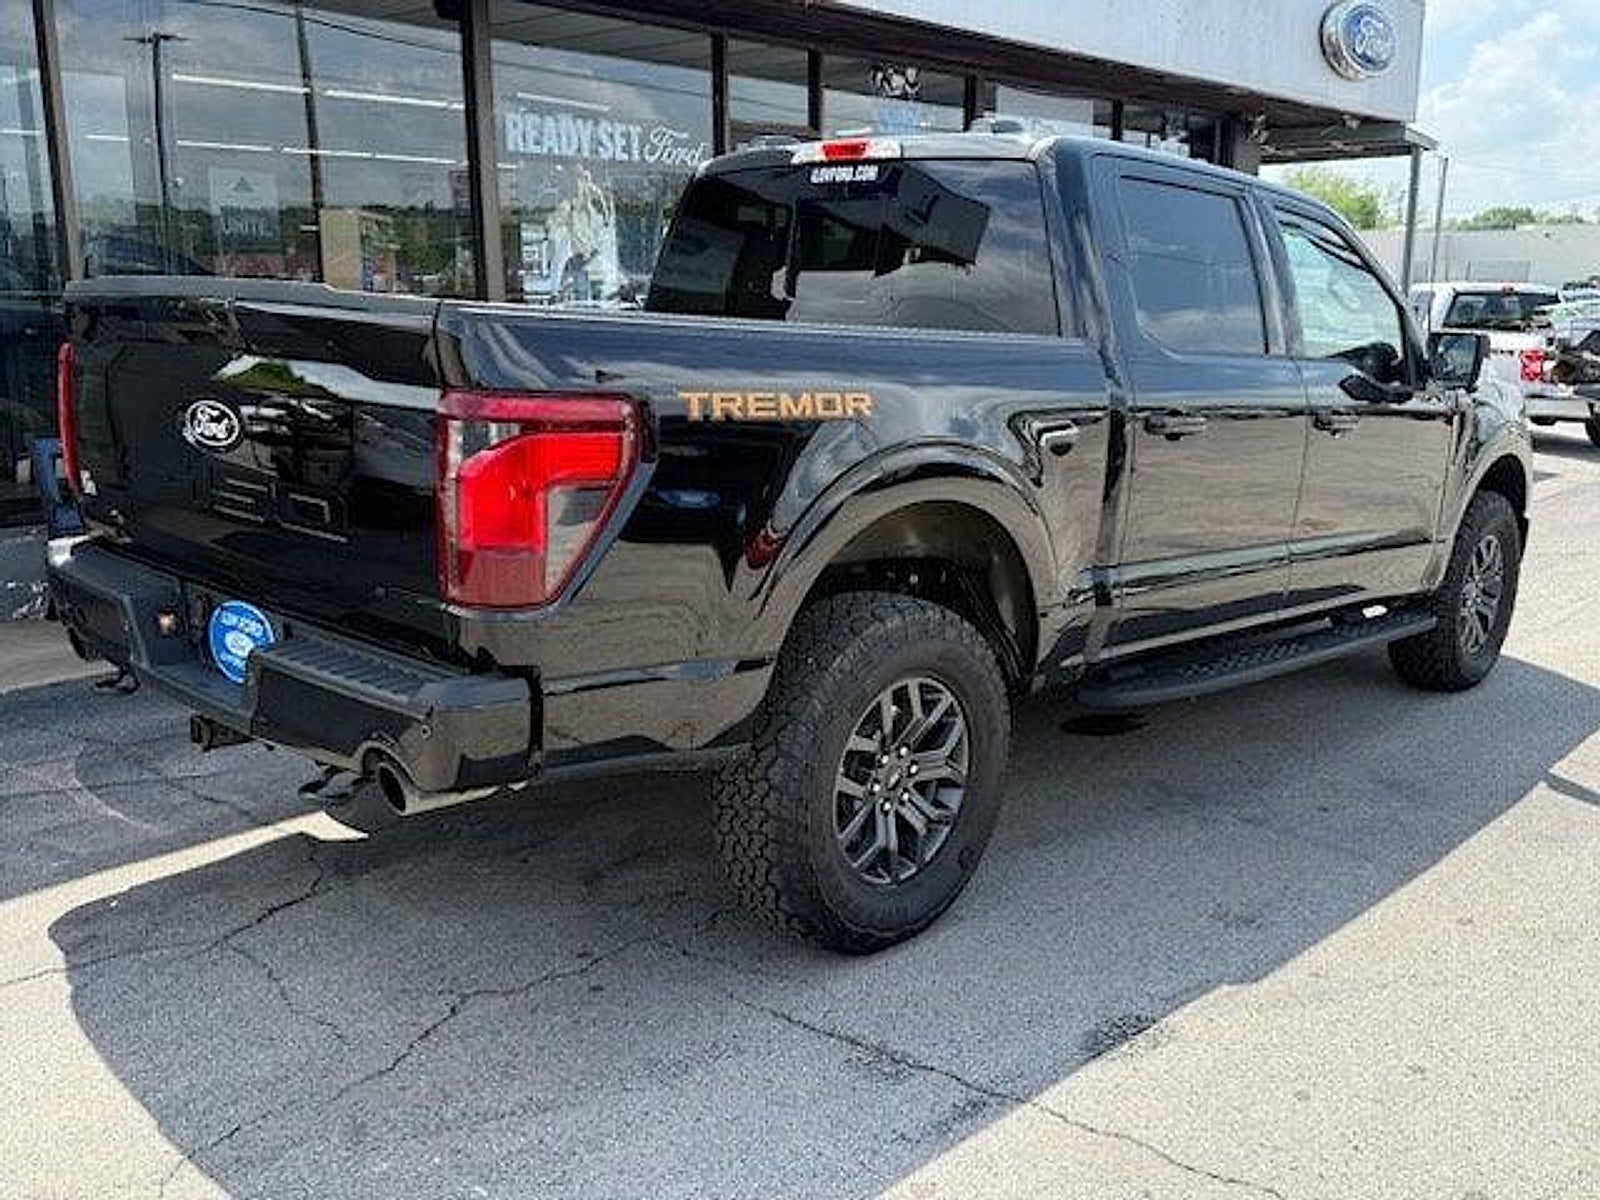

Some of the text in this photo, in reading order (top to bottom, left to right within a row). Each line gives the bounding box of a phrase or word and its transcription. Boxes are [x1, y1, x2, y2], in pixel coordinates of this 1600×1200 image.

[505, 111, 593, 157] READY
[596, 117, 642, 161] SET
[679, 391, 873, 421] TREMOR
